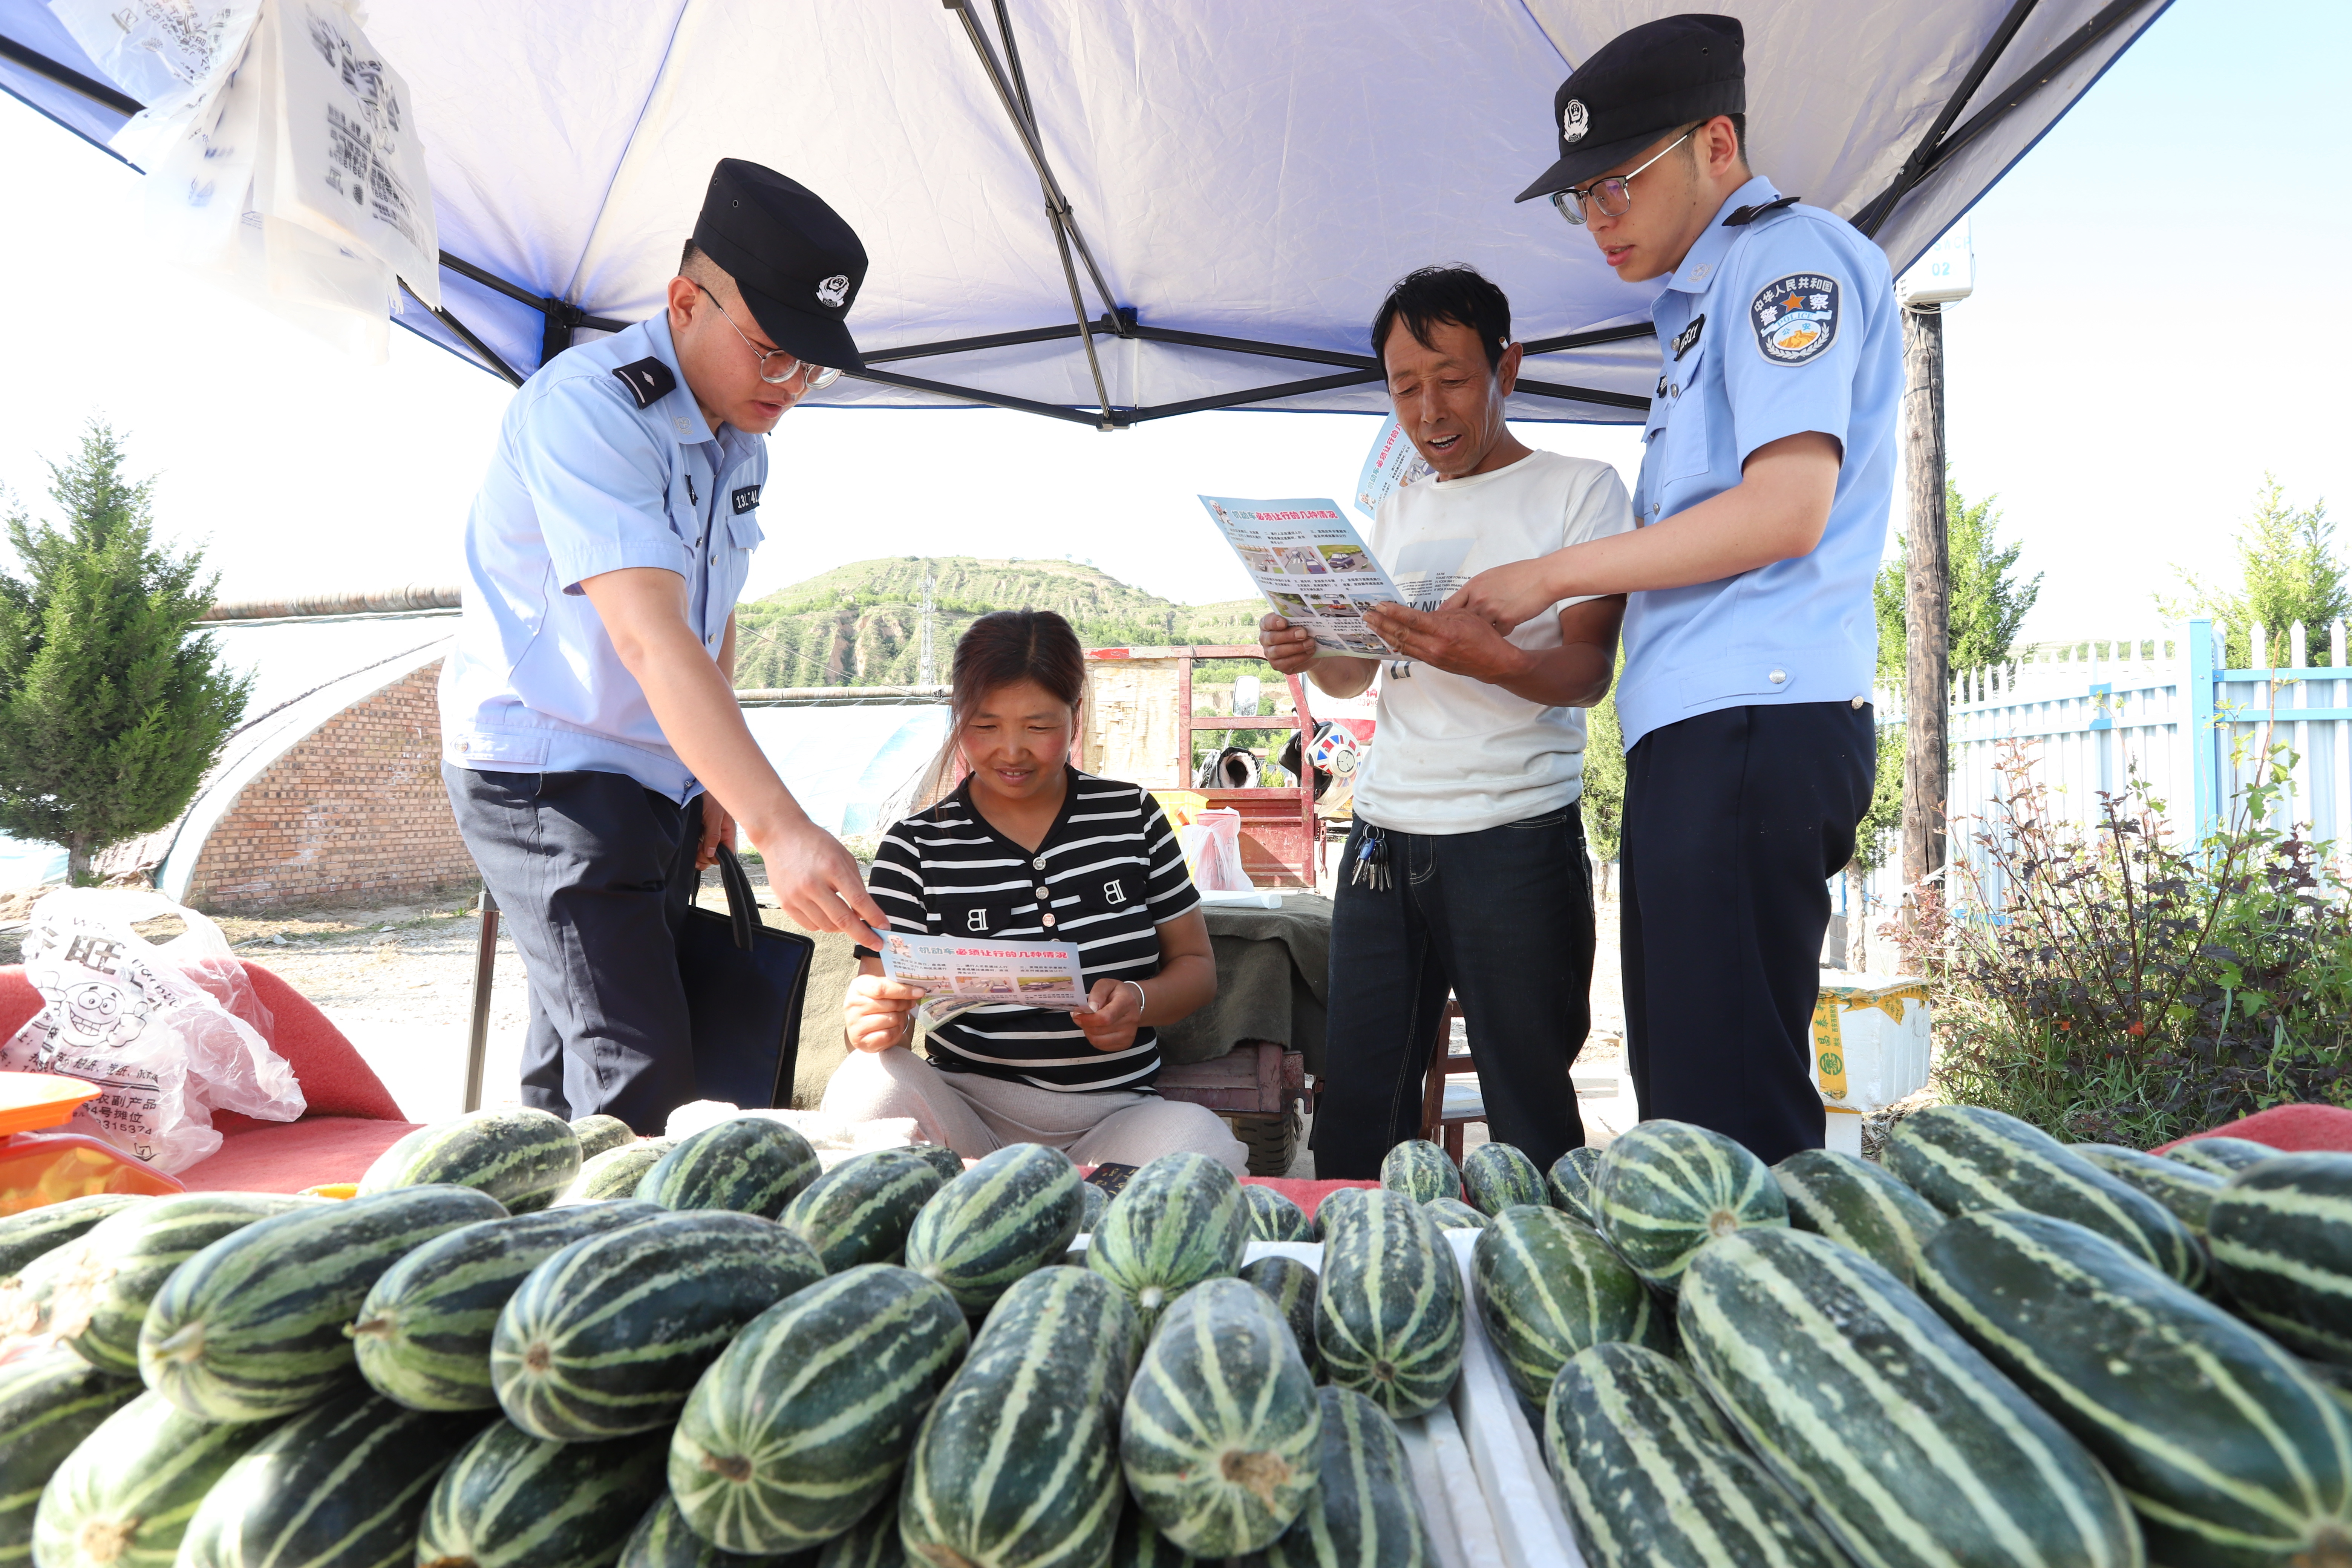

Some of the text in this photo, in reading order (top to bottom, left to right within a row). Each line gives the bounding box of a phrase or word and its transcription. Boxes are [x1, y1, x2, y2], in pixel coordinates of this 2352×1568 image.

[1932, 262, 1950, 276] 02
[1754, 277, 1833, 312] 中华人民共和国
[1776, 312, 1813, 327] POLICE
[1232, 510, 1339, 521] 机动车必须让行的几种情况
[919, 946, 1069, 959] 机动车必须让行的几种情况
